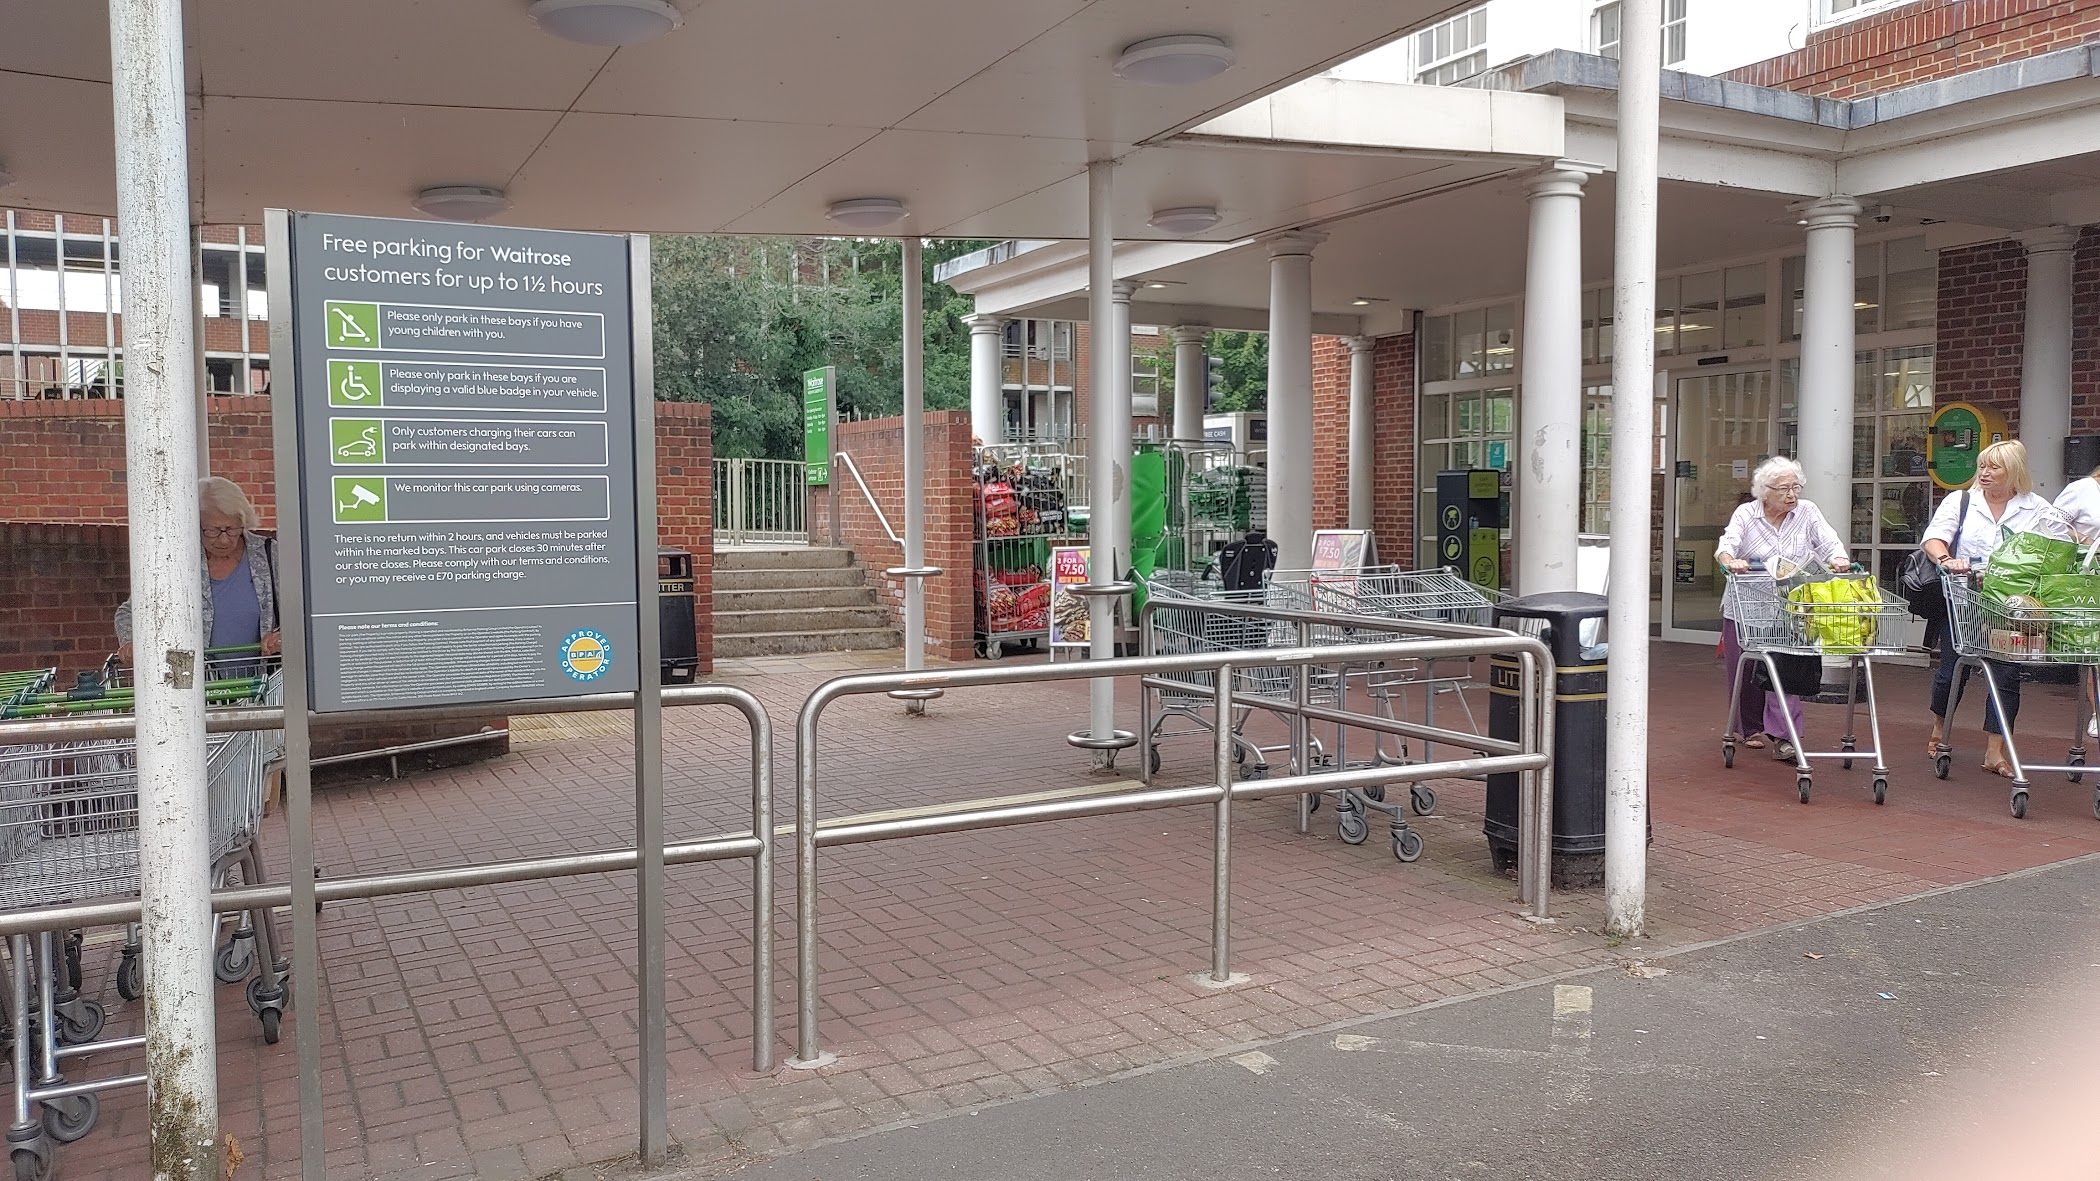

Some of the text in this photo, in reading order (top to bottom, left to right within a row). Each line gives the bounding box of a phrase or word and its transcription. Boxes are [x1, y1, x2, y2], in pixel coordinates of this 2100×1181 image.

[323, 233, 571, 266] Free parking for Waitrose
[324, 263, 603, 295] customers for up to 1½ hours
[387, 310, 582, 329] Please only park in these bays if you have
[388, 326, 505, 341] young children with you.
[390, 368, 422, 379] Please
[424, 370, 445, 382] only
[447, 370, 471, 382] park
[472, 371, 481, 381] in
[483, 371, 509, 381] these
[510, 372, 533, 384] bays
[535, 373, 541, 382] if
[542, 376, 560, 385] you
[390, 383, 441, 396] displaying
[452, 385, 475, 394] valid
[477, 385, 498, 395] blue
[499, 385, 531, 398] badge
[533, 386, 541, 396] in
[543, 389, 564, 399] your
[566, 387, 599, 397] vehicle.
[392, 426, 415, 438] Only
[417, 426, 467, 436] customers
[469, 427, 512, 439] charging
[513, 427, 535, 437] their
[393, 440, 531, 453] park within designated bays.
[394, 483, 411, 492] We
[413, 482, 452, 492] monitor
[454, 482, 471, 492] this
[490, 482, 513, 494] park
[515, 482, 539, 494] using
[334, 534, 363, 543] There
[364, 534, 371, 543] is
[387, 533, 417, 542] return
[418, 532, 446, 541] within
[448, 533, 454, 541] 2
[456, 532, 484, 541] hours,
[485, 531, 504, 540] and
[505, 531, 540, 540] vehicles
[541, 530, 562, 539] must
[564, 530, 576, 539] be
[577, 529, 607, 541] parked
[335, 547, 364, 557] within
[366, 546, 382, 556] the
[383, 546, 420, 555] marked
[422, 546, 447, 557] bays.
[448, 545, 467, 554] This
[485, 544, 507, 556] park
[508, 544, 535, 553] closes
[537, 544, 548, 552] 30
[550, 542, 583, 552] minutes
[585, 542, 606, 551] after
[1319, 546, 1340, 559] £7.50
[354, 560, 379, 570] store
[380, 560, 411, 569] closes.
[413, 559, 443, 568] Please
[444, 558, 479, 569] comply
[480, 557, 500, 566] with
[519, 556, 544, 565] terms
[545, 555, 562, 564] and
[1060, 563, 1085, 575] £7.50
[349, 576, 367, 586] you
[369, 575, 390, 584] may
[392, 572, 426, 582] receive
[455, 570, 491, 582] parking
[492, 570, 527, 580] charge.
[658, 583, 685, 592] ITTER
[561, 630, 610, 653] APPROVED
[562, 658, 610, 680] OPERATOR
[1498, 668, 1520, 687] LIT
